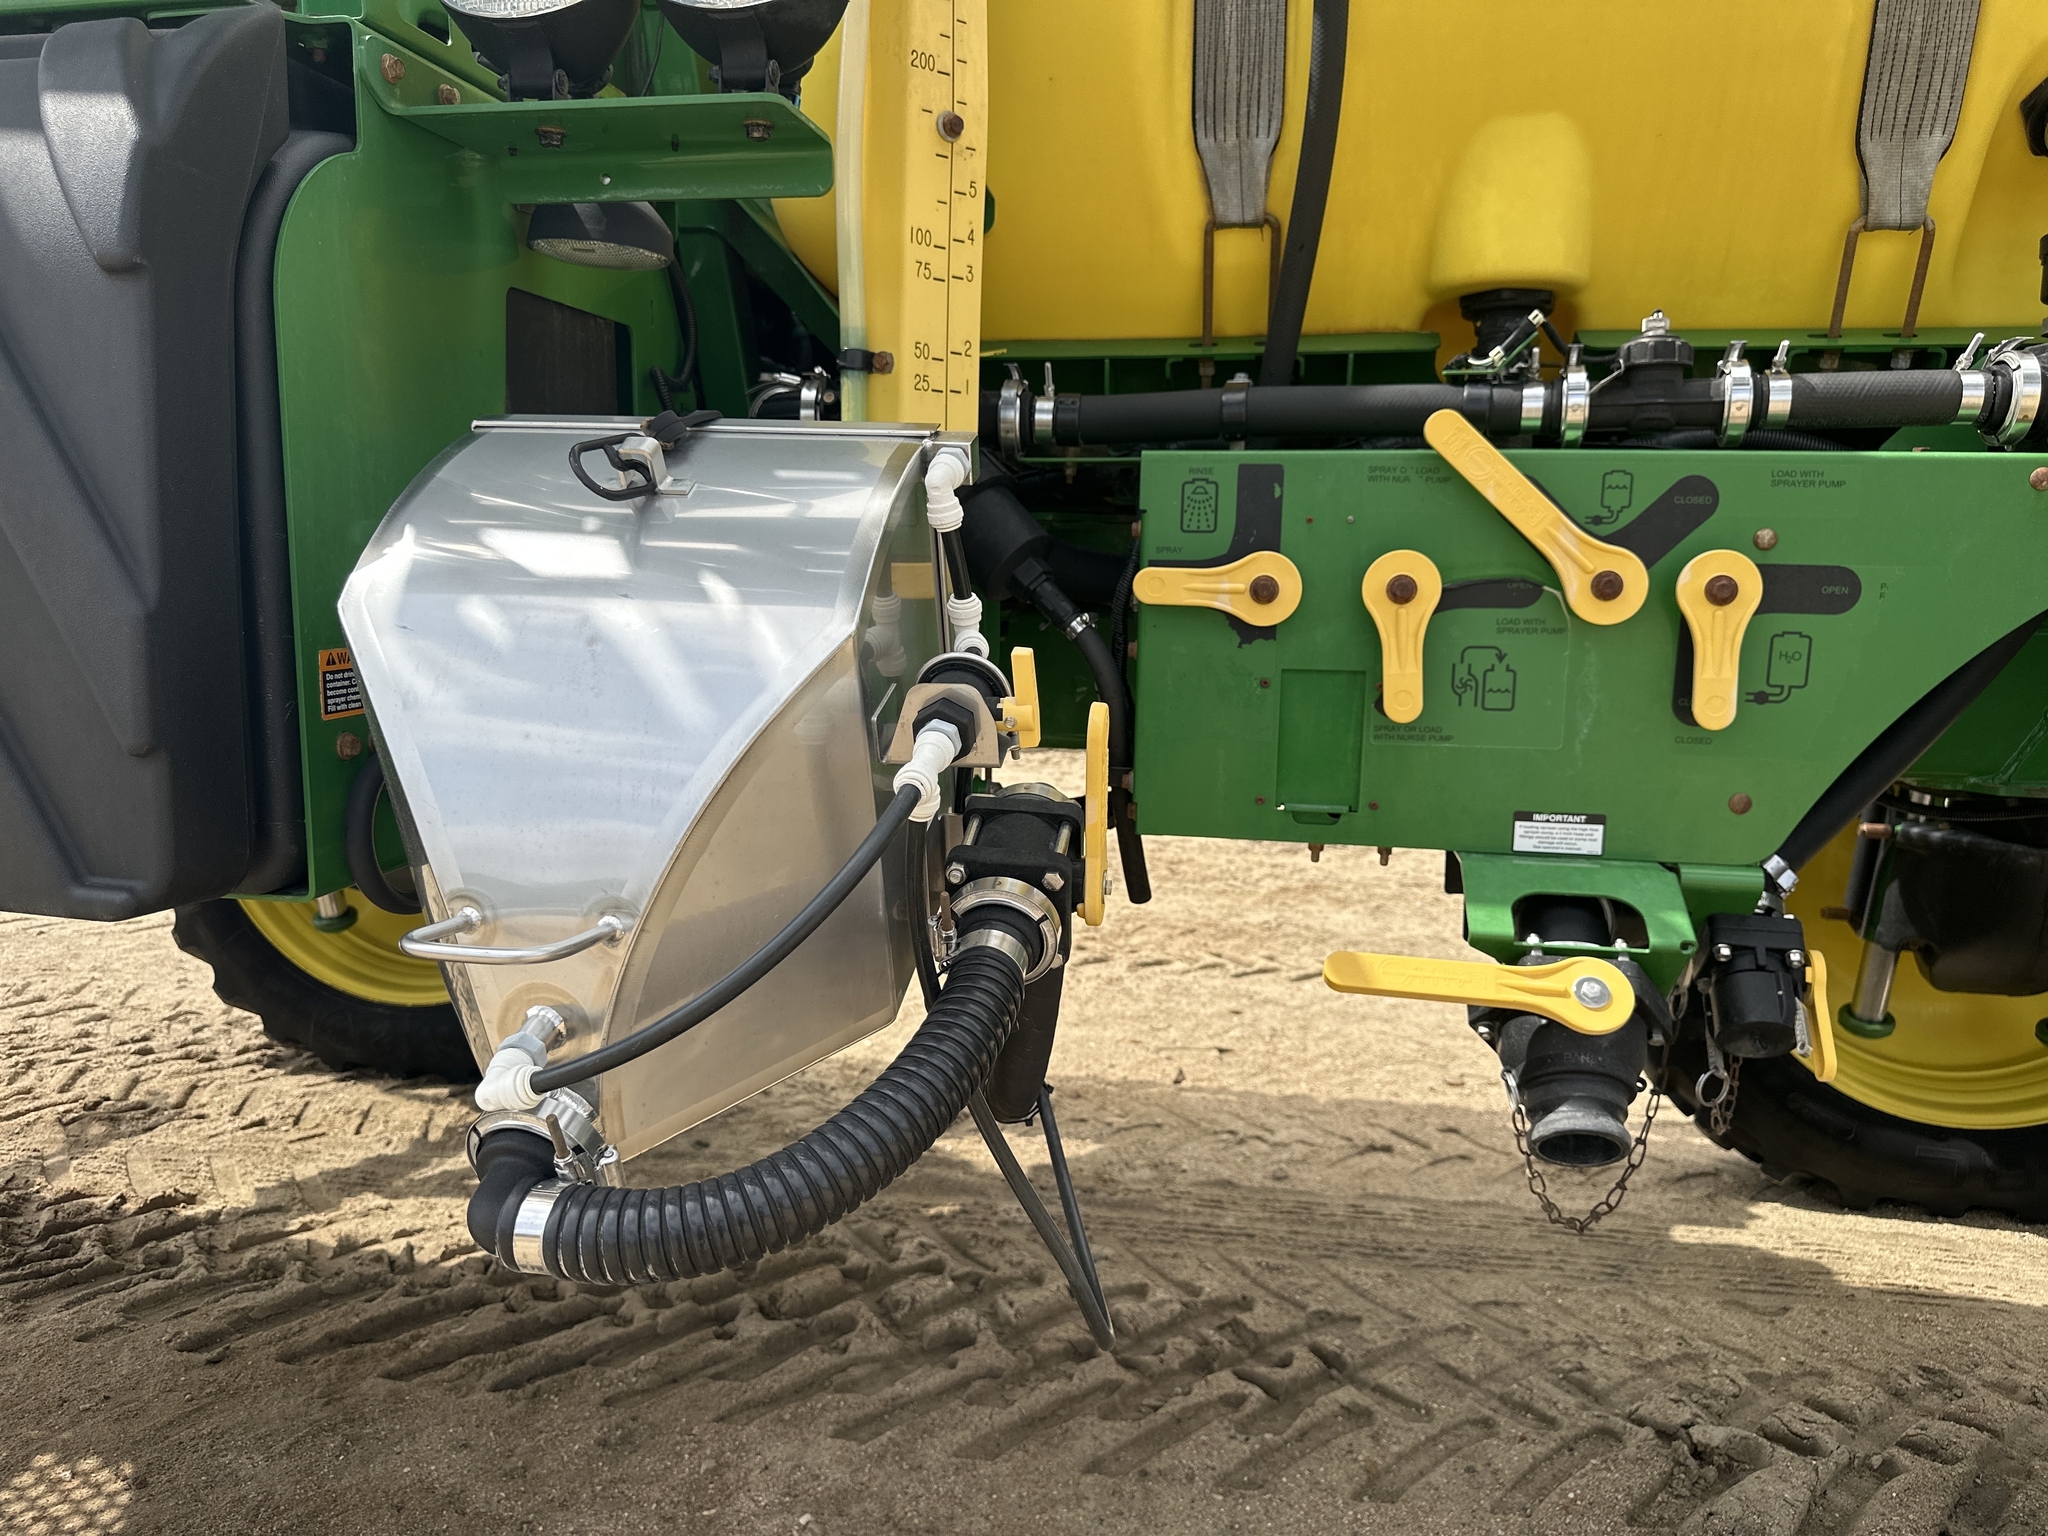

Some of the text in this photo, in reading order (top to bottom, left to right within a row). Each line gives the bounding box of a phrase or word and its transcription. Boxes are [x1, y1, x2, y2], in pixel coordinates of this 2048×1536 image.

[910, 49, 936, 73] 200
[968, 182, 978, 199] 5
[910, 226, 932, 248] 100
[967, 229, 976, 246] 4
[915, 260, 932, 281] 75
[965, 265, 975, 283] 3
[913, 341, 931, 361] 50
[963, 340, 973, 358] 2
[913, 374, 931, 393] 25
[1188, 467, 1214, 475] RINSE
[1367, 465, 1398, 474] SPRAY
[1415, 466, 1440, 475] LOAD
[1771, 469, 1825, 478] LOAD WITH
[1367, 475, 1390, 483] WITH
[1425, 476, 1451, 484] PUMP
[1770, 479, 1847, 488] SPRAYER PUMP
[1673, 494, 1713, 505] CLOSED
[1155, 546, 1183, 554] SPRAY
[1821, 585, 1849, 595] OPEN
[1496, 617, 1546, 626] LOAD WITH
[1496, 626, 1566, 636] SPRAYER PUMP
[1373, 724, 1443, 734] SPRAY OR LOAD
[1373, 733, 1396, 741] WITH
[1428, 734, 1455, 742] PUMP
[1674, 735, 1713, 745] CLOSED
[1532, 812, 1588, 823] IMPORTANT
